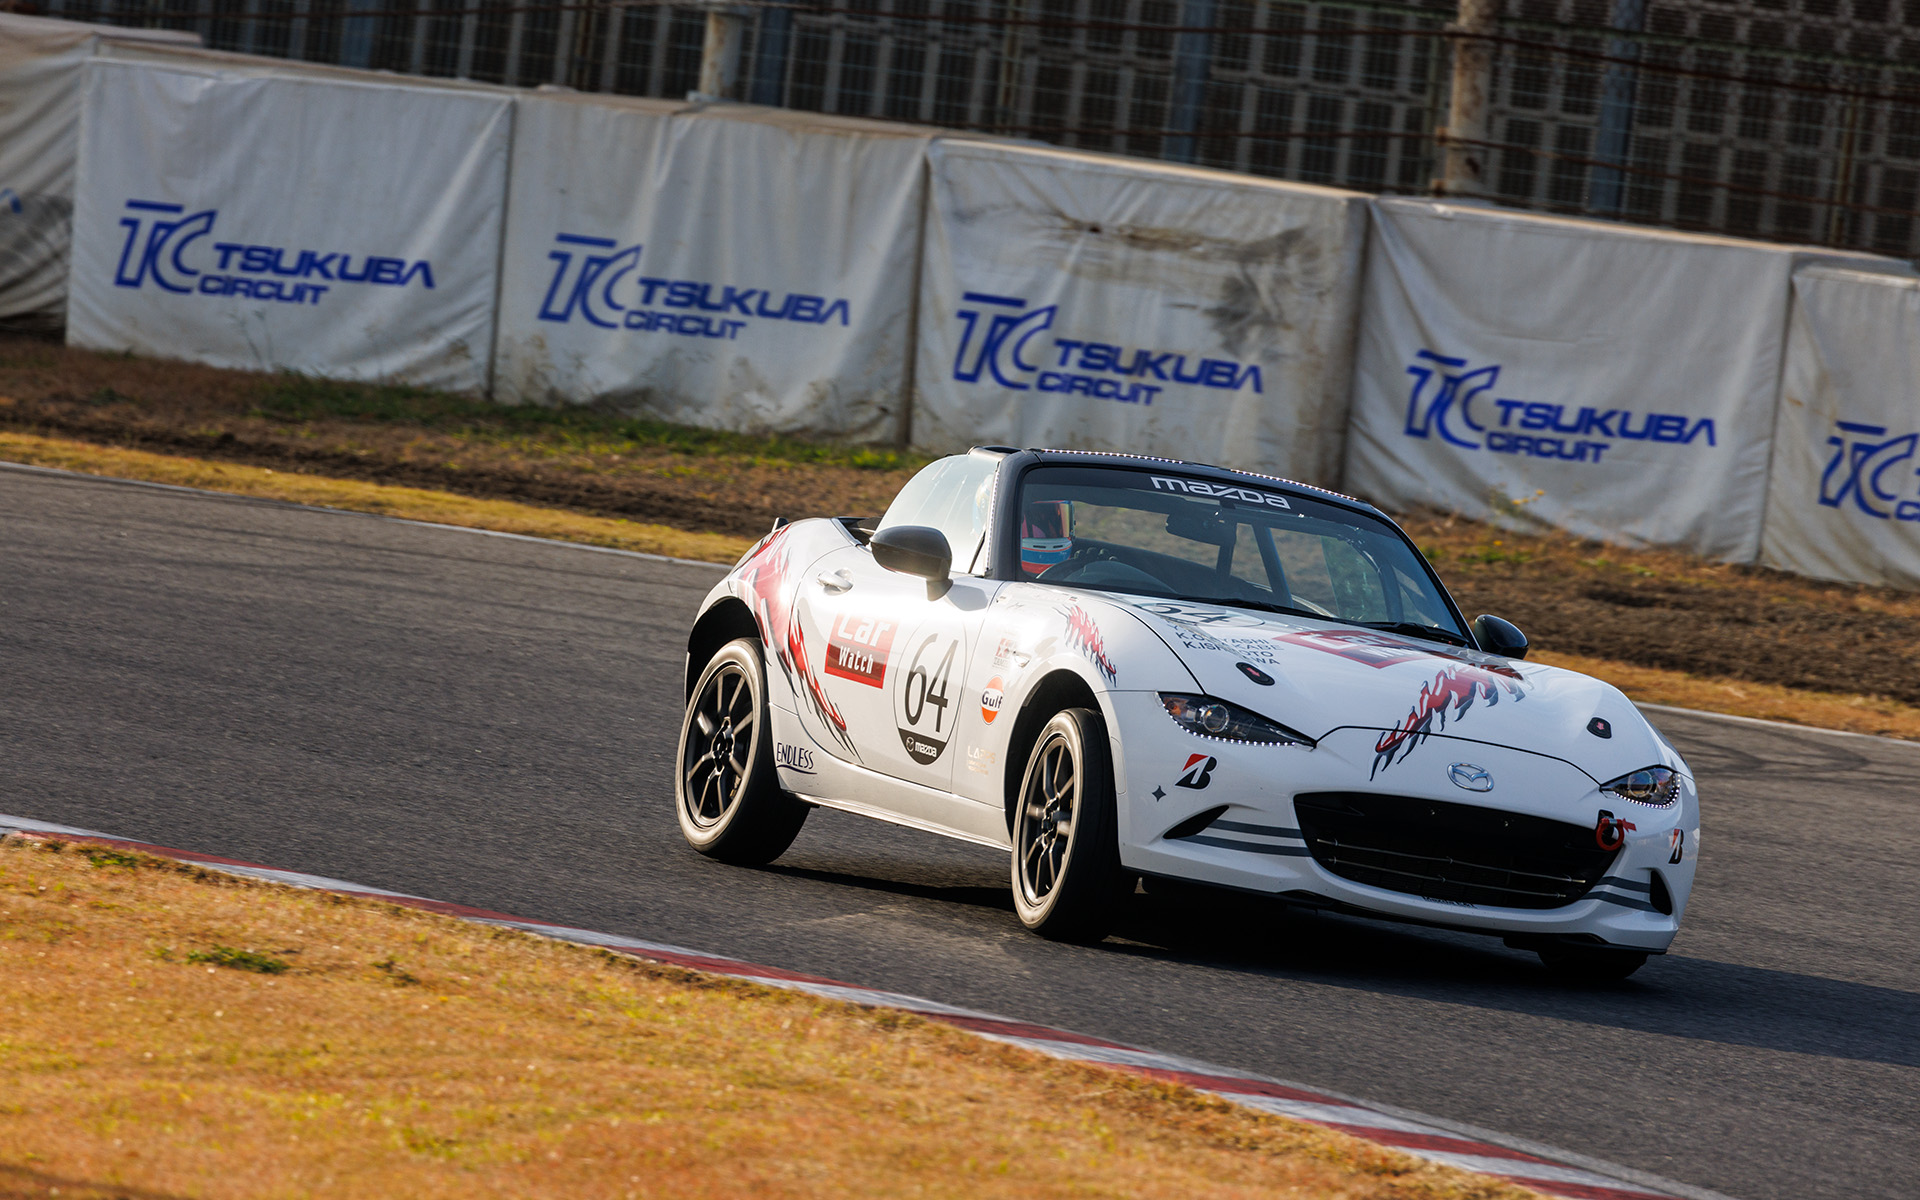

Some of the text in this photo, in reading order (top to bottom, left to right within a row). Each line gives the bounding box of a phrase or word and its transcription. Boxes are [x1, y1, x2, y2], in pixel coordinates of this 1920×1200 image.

[213, 242, 436, 289] TSUKUBA
[198, 274, 329, 305] CIRCUIT
[638, 277, 849, 326] TSUKUBA
[1054, 338, 1263, 394] TSUKUBA
[1035, 371, 1162, 406] CIRCUIT
[1495, 398, 1717, 447] TSUKUBA
[1485, 431, 1610, 464] CIRCUIT
[1150, 476, 1291, 510] mazda
[838, 645, 874, 675] Watch
[904, 632, 960, 733] 64
[981, 690, 1003, 709] Gulf
[776, 742, 815, 770] ENDLESS
[914, 741, 937, 758] mazda
